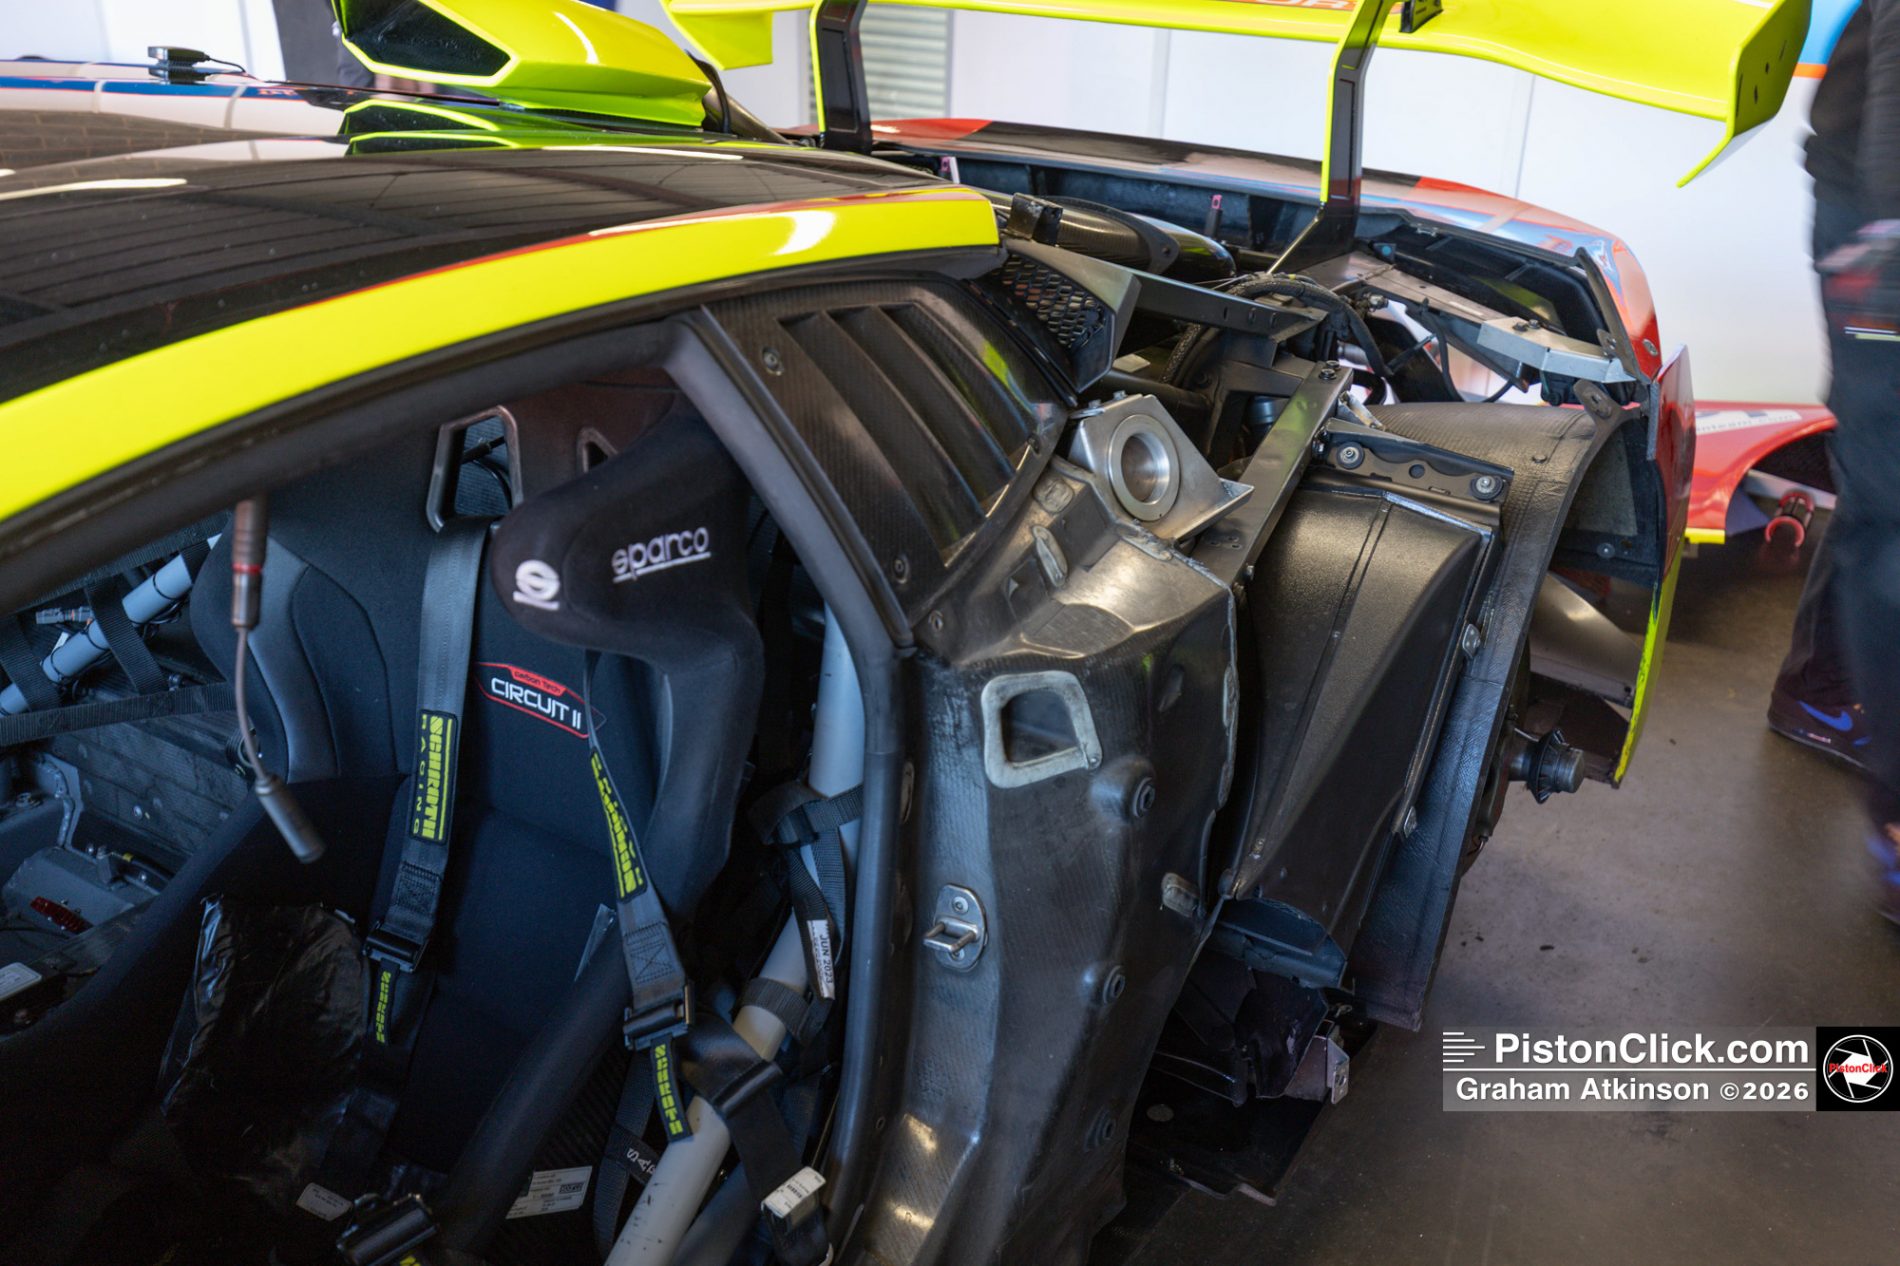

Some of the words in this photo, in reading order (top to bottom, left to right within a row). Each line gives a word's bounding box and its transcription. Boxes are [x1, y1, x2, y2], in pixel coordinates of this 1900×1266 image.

[612, 527, 709, 581] sparco
[491, 677, 570, 721] CIRCUIT
[413, 713, 428, 834] RACING
[422, 715, 443, 839] SCHROTH
[820, 934, 830, 957] JUN
[823, 960, 833, 984] 2023
[655, 1044, 683, 1135] SCHROTH
